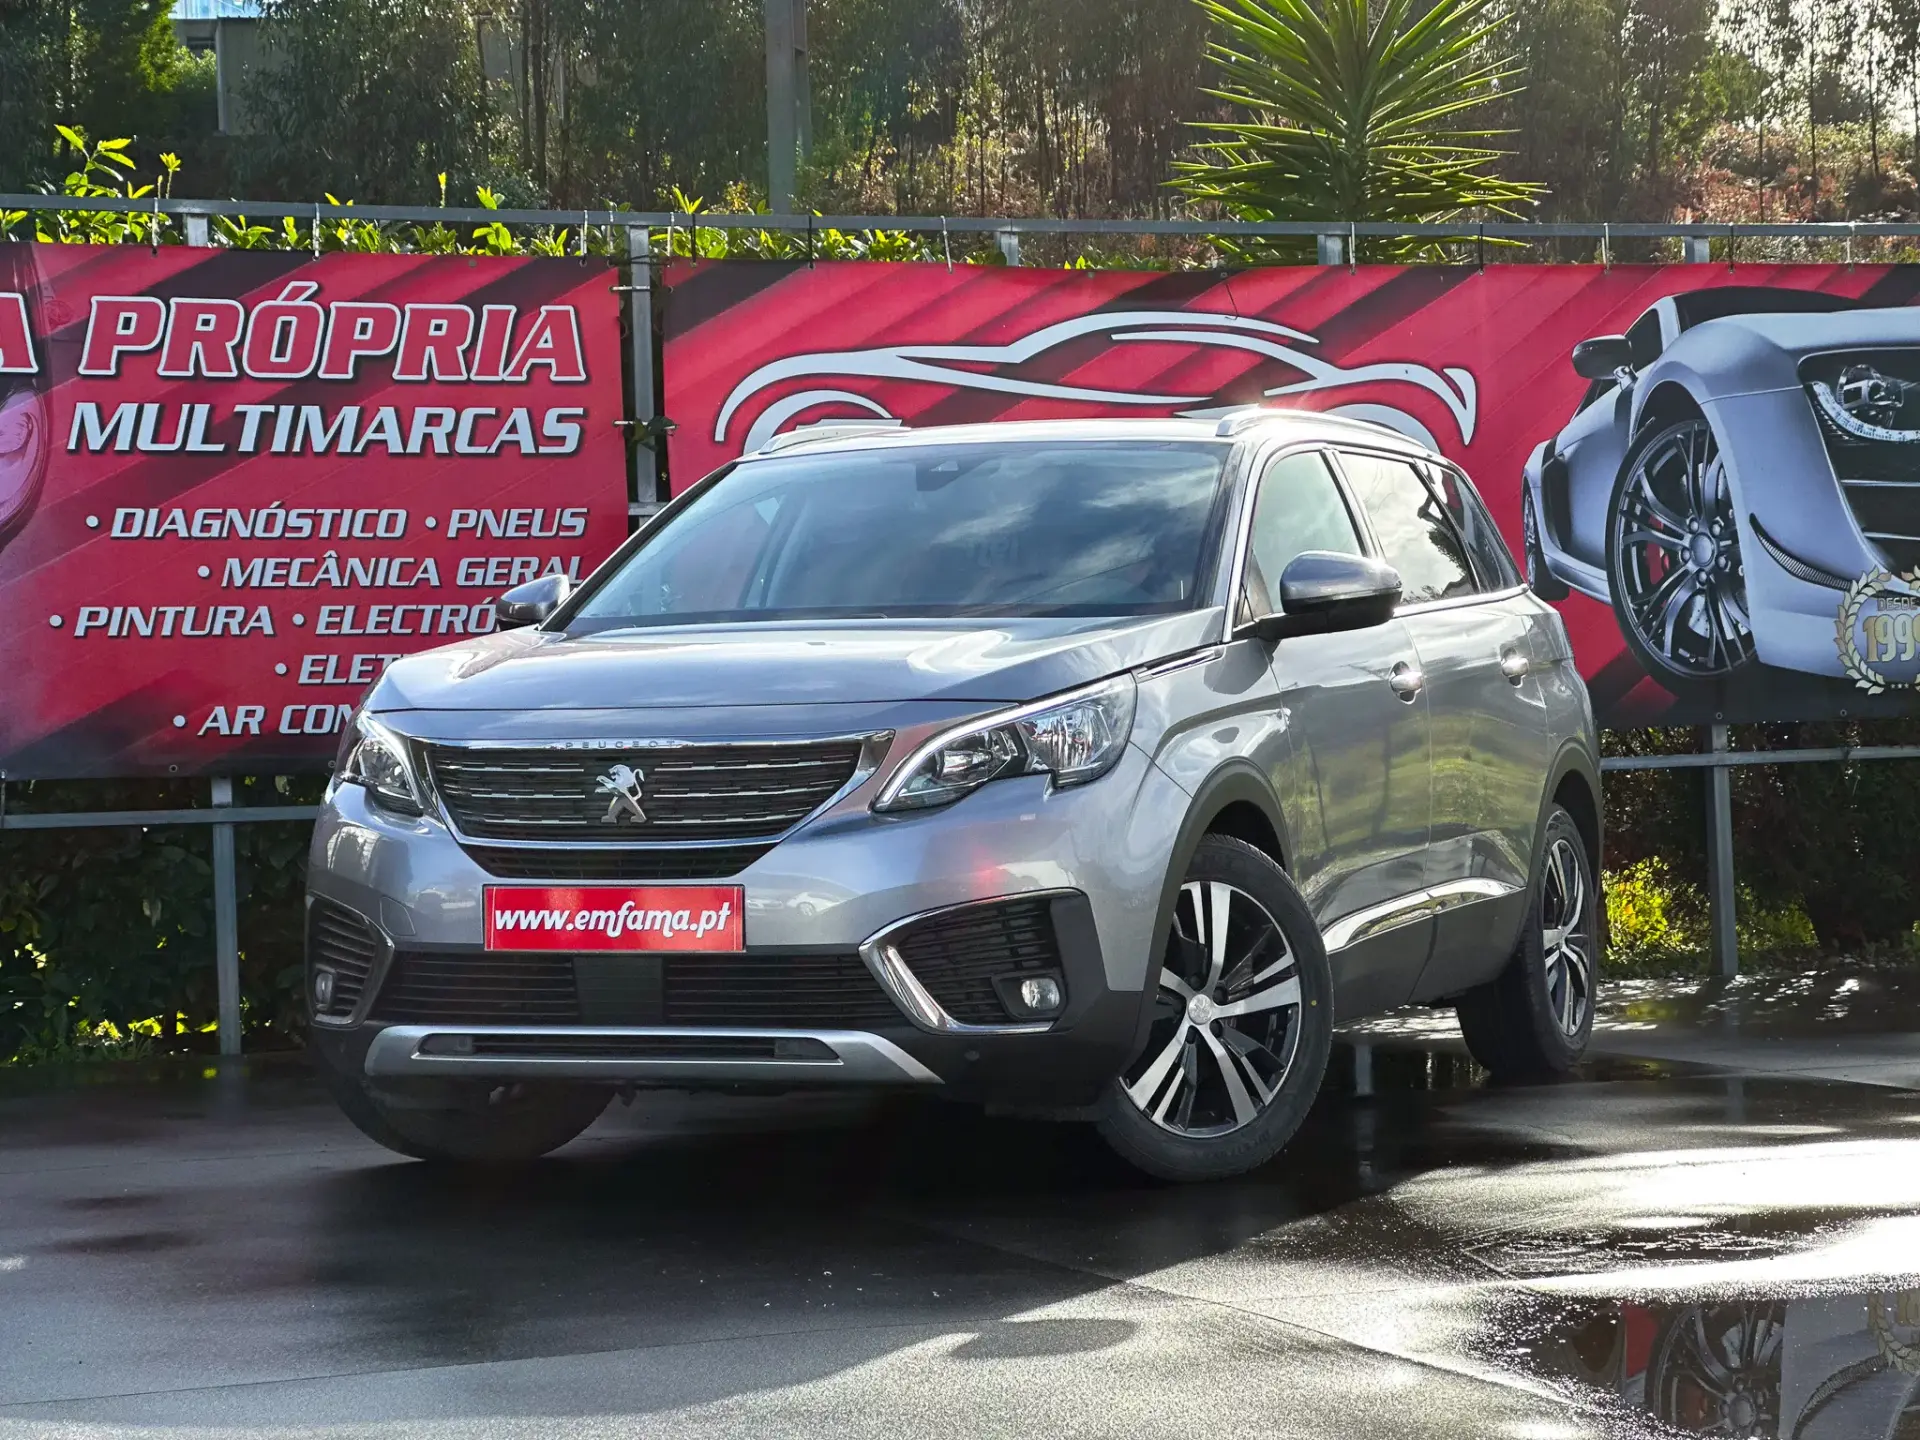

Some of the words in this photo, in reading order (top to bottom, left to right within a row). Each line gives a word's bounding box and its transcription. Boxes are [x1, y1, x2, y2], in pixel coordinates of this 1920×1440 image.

[78, 281, 586, 381] PRÓPRIA
[67, 402, 584, 454] MULTIMARCAS
[110, 502, 407, 539] DIAGNÓSTICO
[447, 507, 588, 538] PNEUS
[221, 550, 441, 588] MECÂNICA
[456, 556, 584, 586] GERAL
[74, 605, 274, 638] PINTURA
[1878, 596, 1918, 612] DESDE
[198, 706, 264, 736] AR
[565, 739, 676, 749] PEUGEOT
[495, 901, 730, 938] www.emfama.pt
